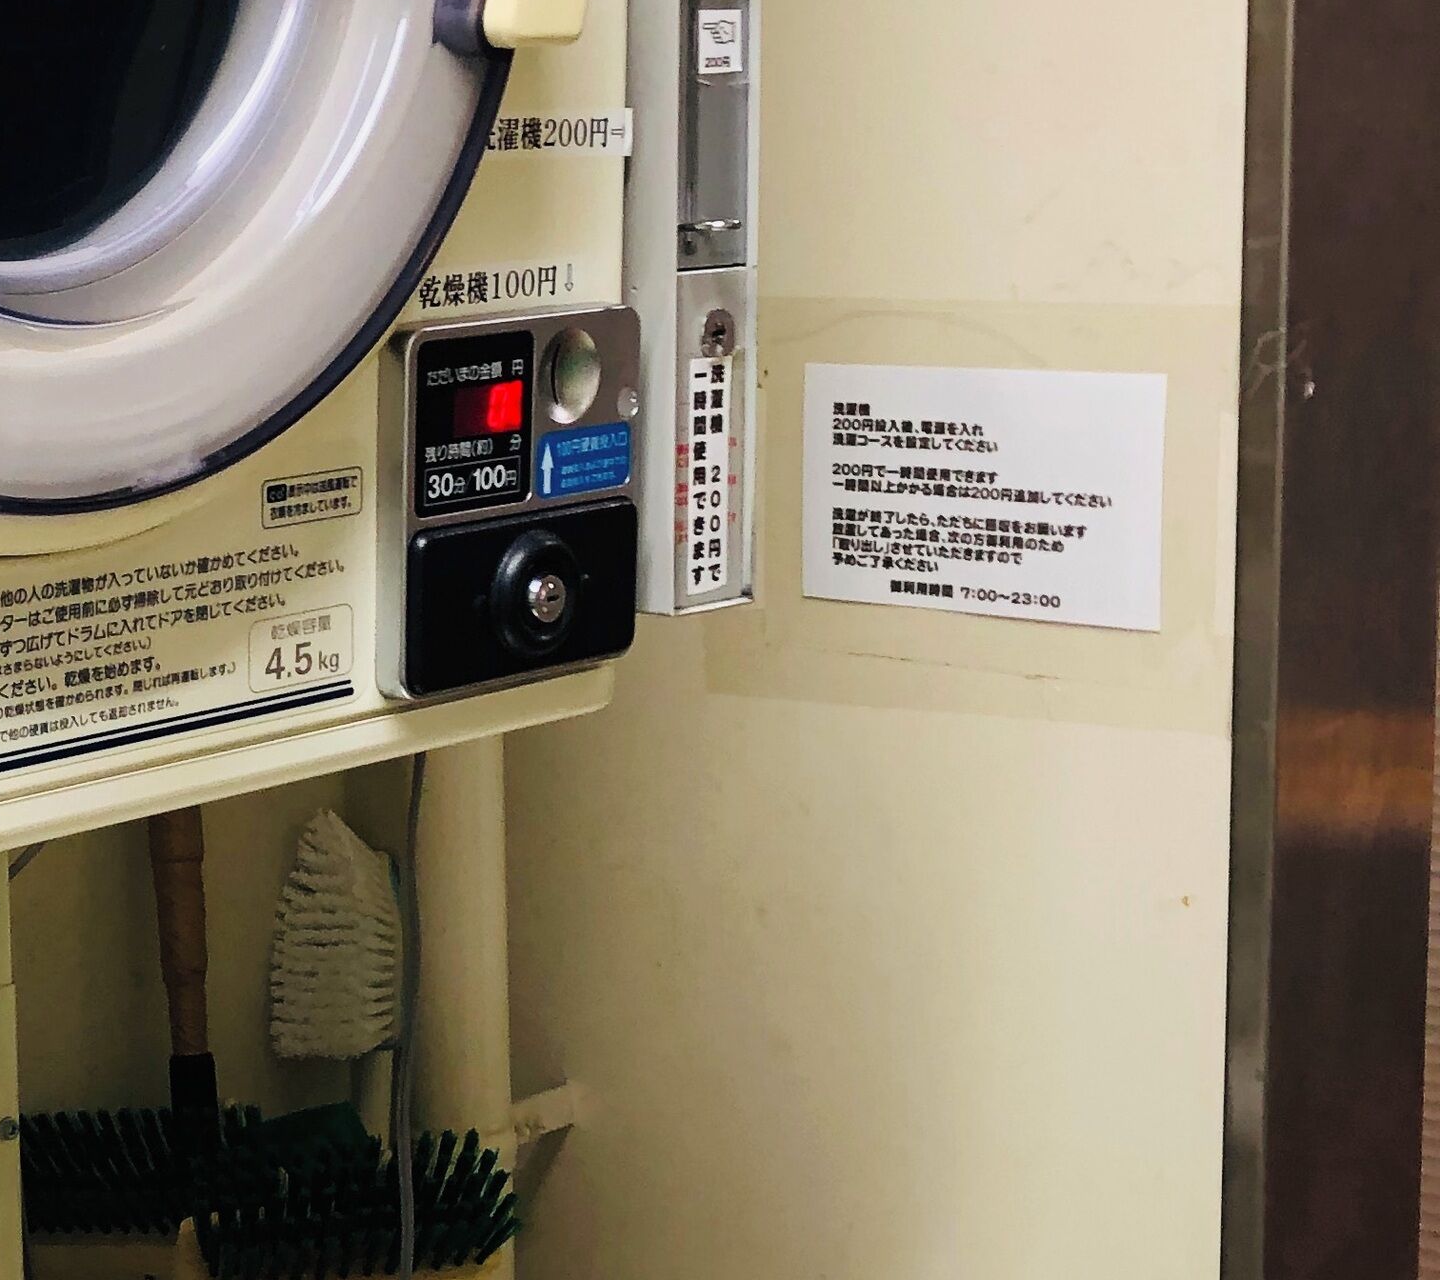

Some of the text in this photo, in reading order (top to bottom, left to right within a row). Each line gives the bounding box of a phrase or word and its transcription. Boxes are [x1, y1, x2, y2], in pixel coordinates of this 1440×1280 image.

[418, 266, 557, 309] 乾燥機100円
[512, 359, 524, 375] 円
[271, 614, 332, 640] 乾燥容量
